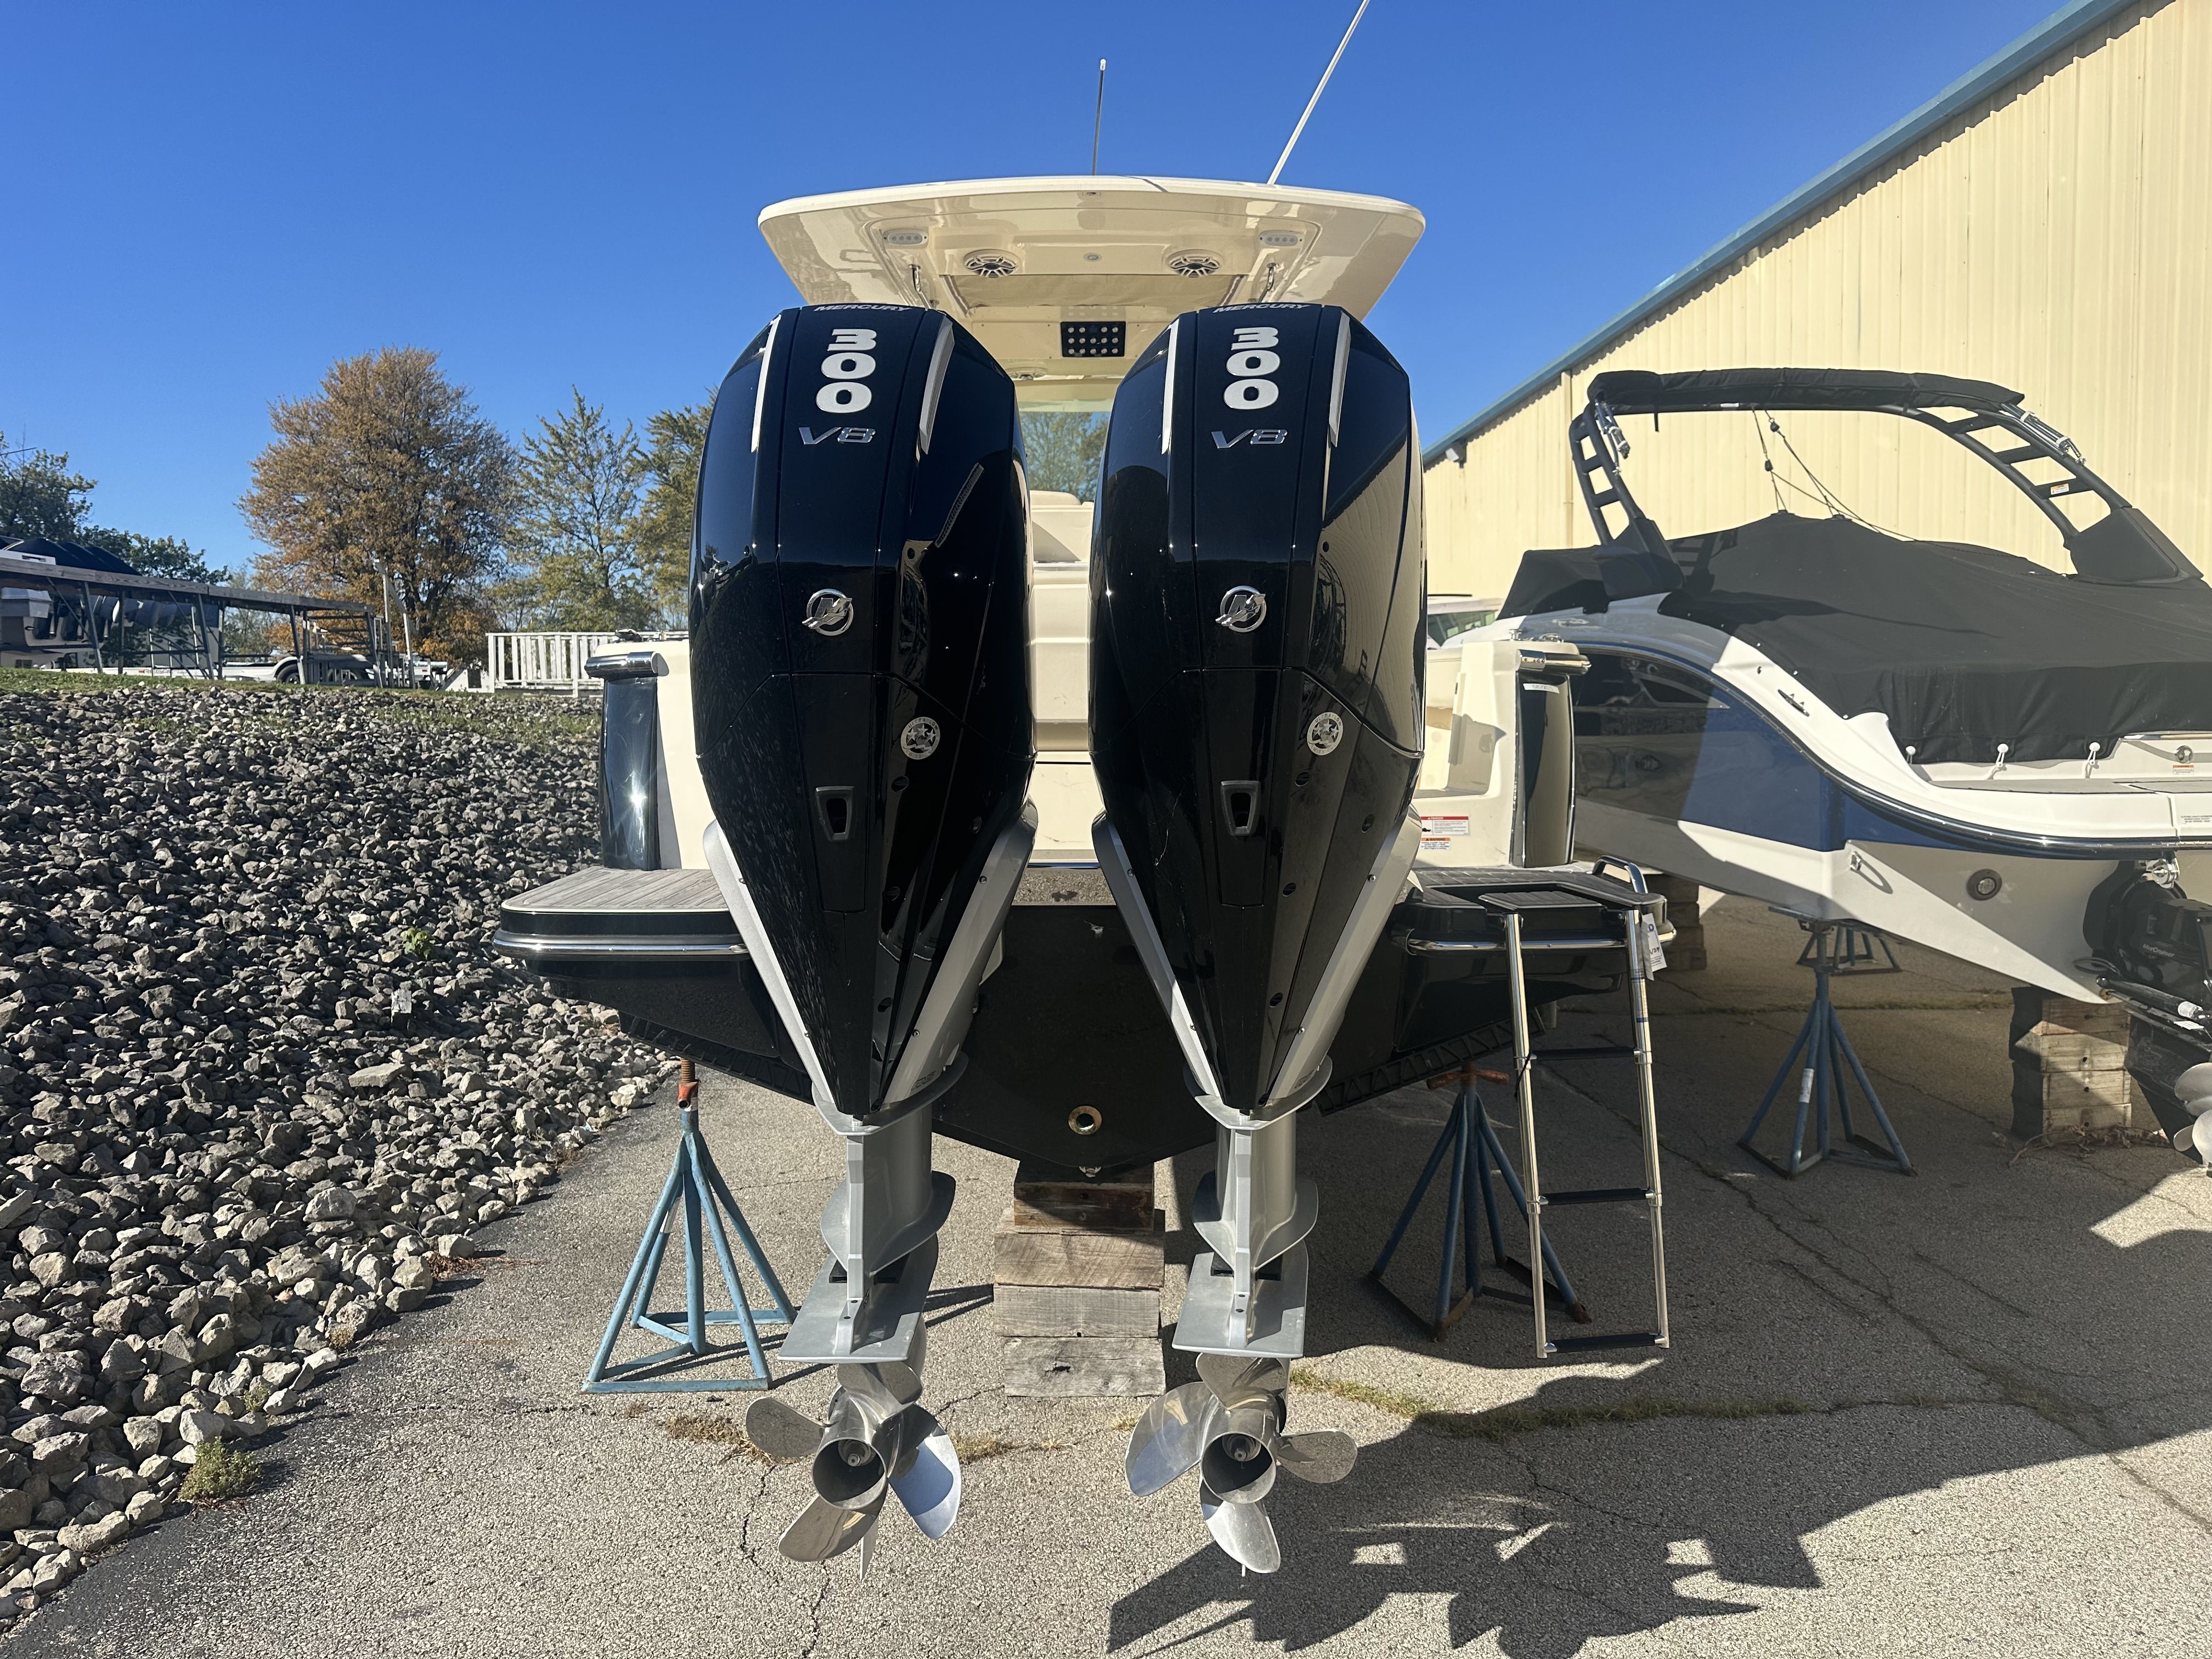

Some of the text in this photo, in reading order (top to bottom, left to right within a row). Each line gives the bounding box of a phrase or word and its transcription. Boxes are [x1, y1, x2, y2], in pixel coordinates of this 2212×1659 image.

[1212, 304, 1311, 314] MERCURY
[816, 329, 877, 414] 300
[1223, 326, 1281, 410] 300
[798, 427, 876, 445] V8
[1211, 429, 1288, 449] V8
[1314, 713, 1331, 723] ULTRA
[2142, 944, 2175, 957] MerCruiser
